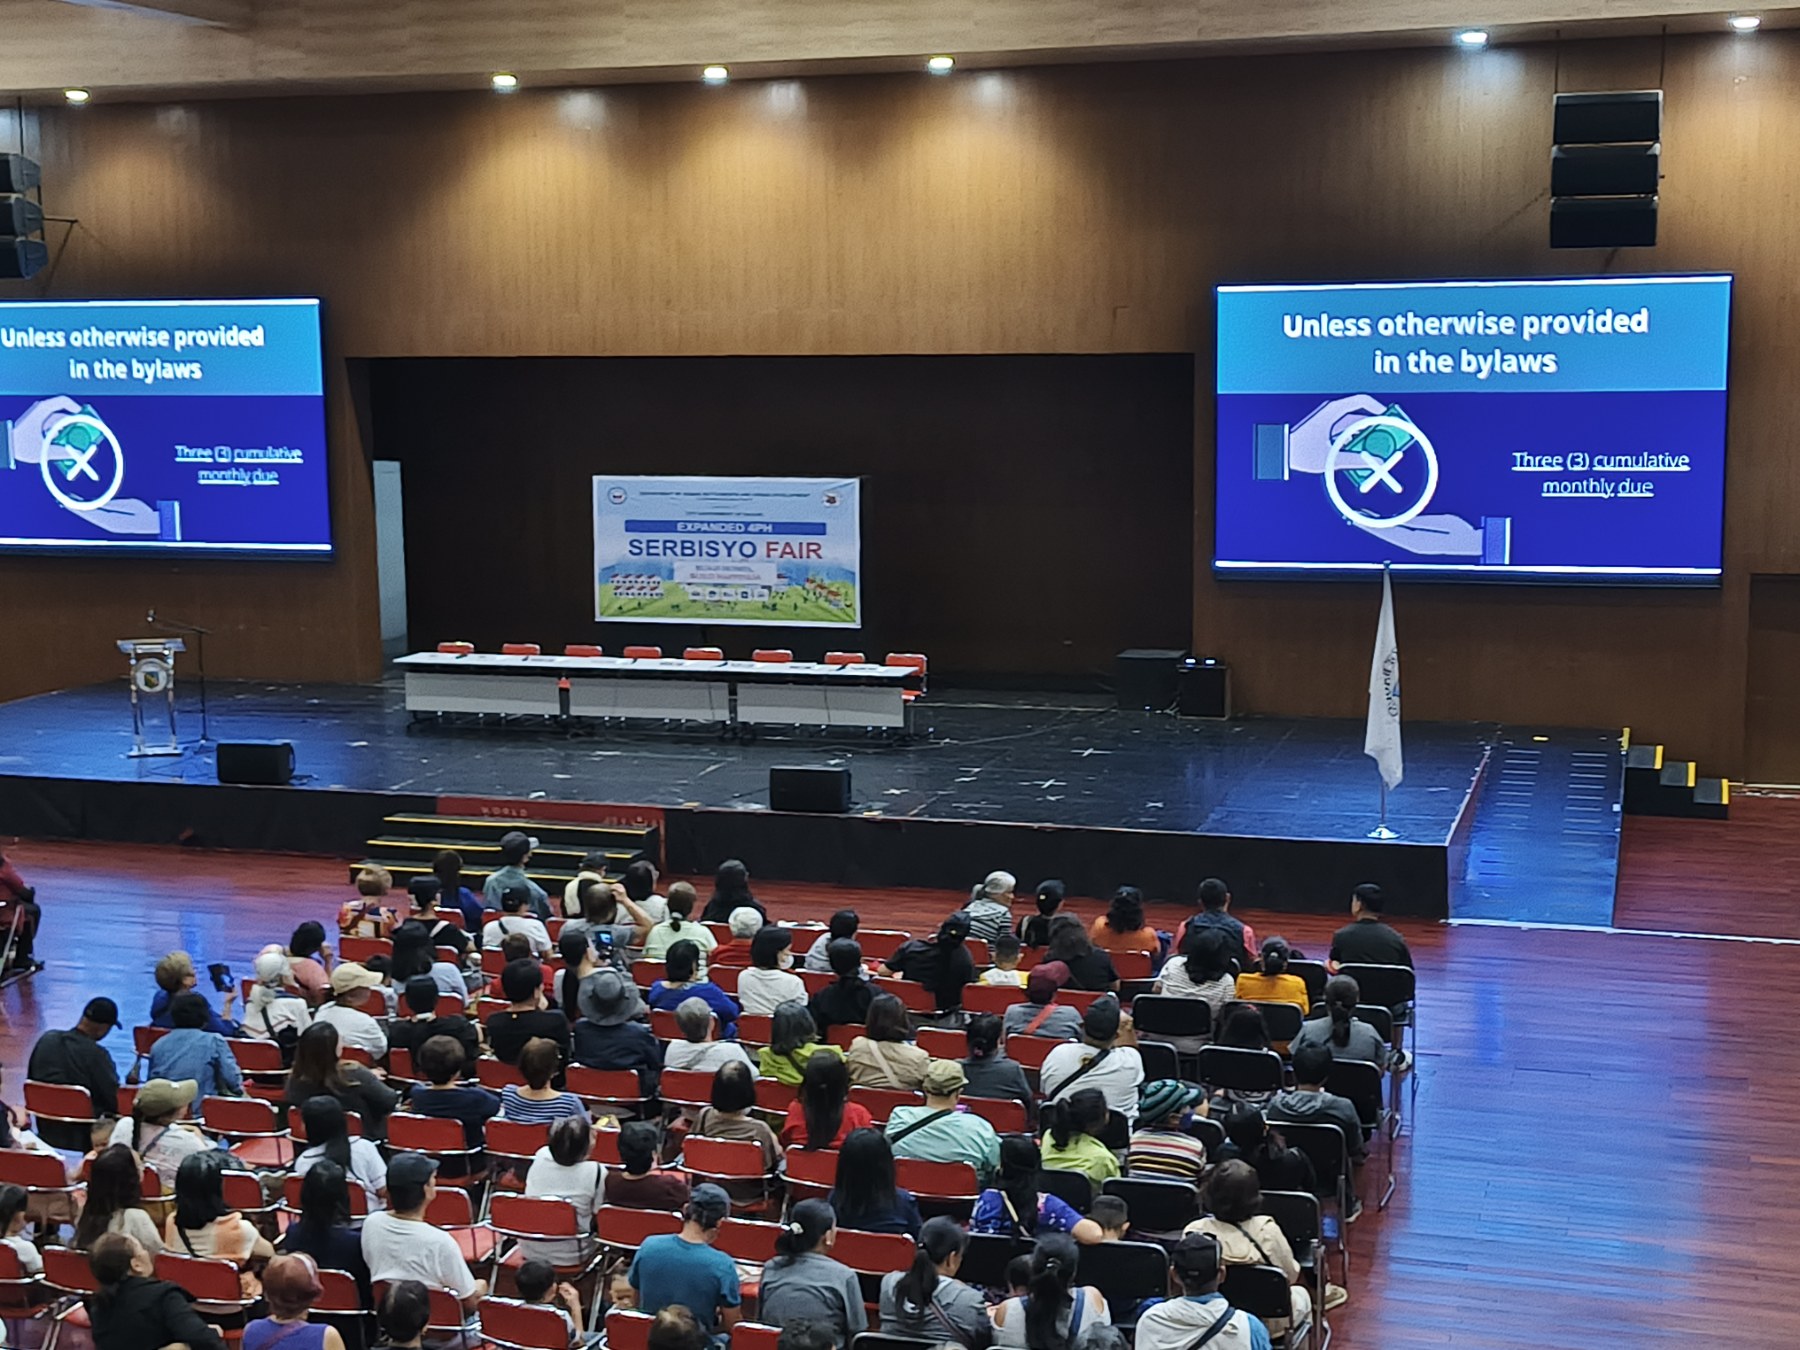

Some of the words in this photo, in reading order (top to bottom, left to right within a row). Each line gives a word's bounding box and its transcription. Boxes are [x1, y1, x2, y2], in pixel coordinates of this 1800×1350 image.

[1282, 312, 1372, 338] Unless
[1377, 311, 1516, 336] otherwise
[1521, 308, 1650, 341] provided
[0, 326, 66, 348] Unless
[69, 325, 170, 347] otherwise
[174, 324, 265, 352] provided
[69, 358, 89, 379] in
[94, 359, 128, 379] the
[131, 358, 203, 384] bylaws
[1373, 349, 1401, 374] in
[1406, 349, 1455, 374] the
[1460, 348, 1558, 380] bylaws
[174, 445, 213, 462] Three
[1511, 452, 1564, 471] Three
[1567, 452, 1590, 471] (3)
[1592, 451, 1691, 471] cumulative
[197, 467, 252, 486] monthly
[252, 468, 280, 485] due
[1541, 477, 1615, 498] monthly
[1617, 477, 1655, 497] due
[676, 522, 745, 533] EXPANDED
[628, 538, 758, 558] SERBISYO
[765, 540, 823, 560] FAIR
